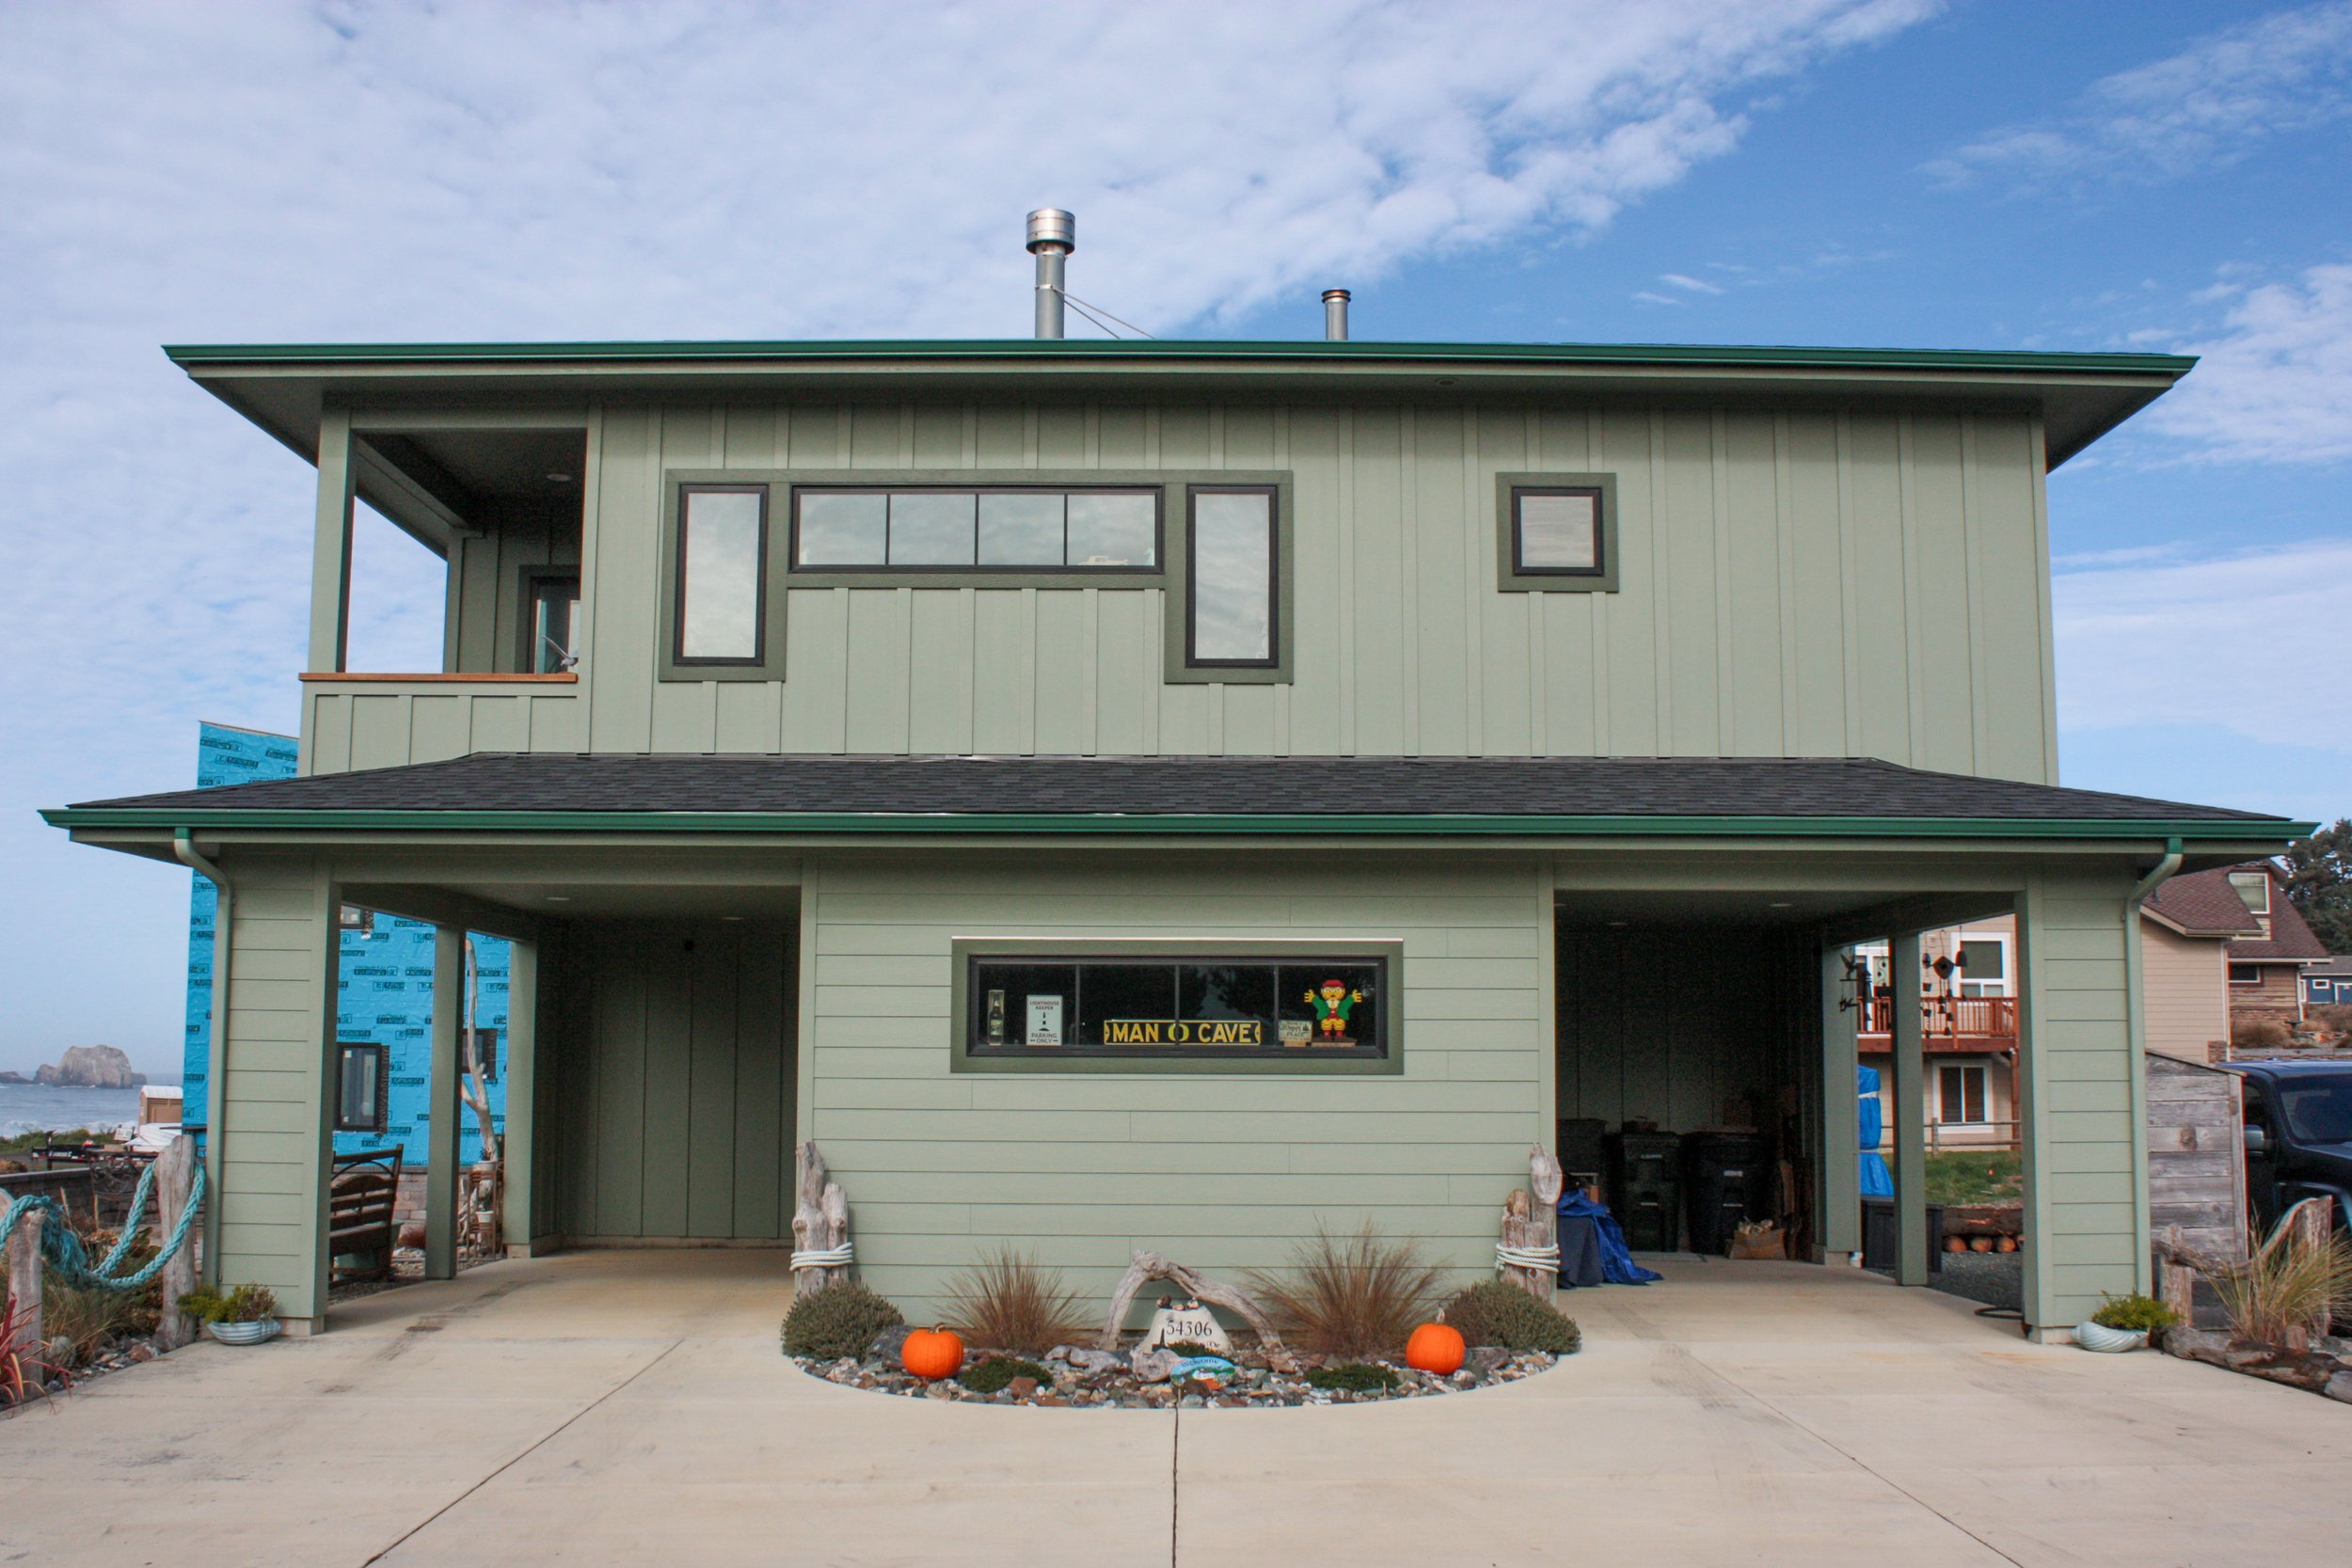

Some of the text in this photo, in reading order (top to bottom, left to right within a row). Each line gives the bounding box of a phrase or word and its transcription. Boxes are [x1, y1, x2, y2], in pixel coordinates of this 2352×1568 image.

[1113, 1023, 1251, 1043] MAN O CAVE
[1167, 1320, 1212, 1336] 54306
